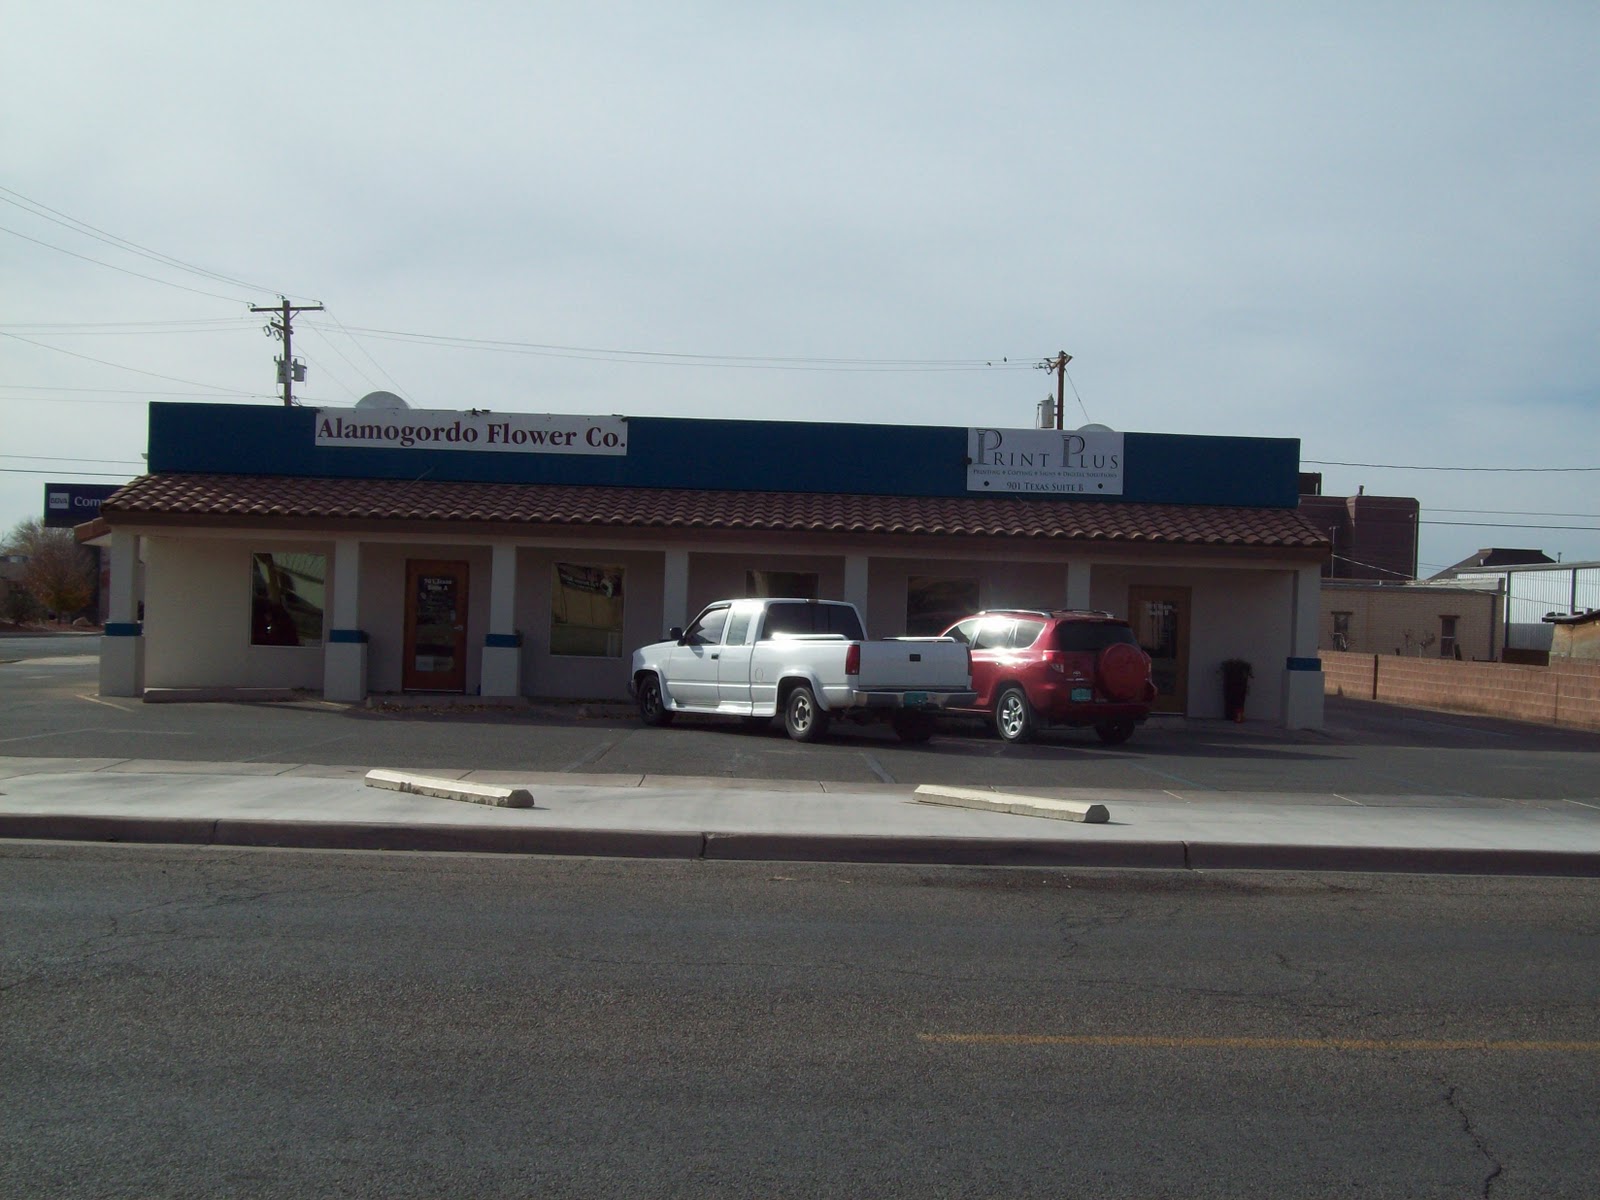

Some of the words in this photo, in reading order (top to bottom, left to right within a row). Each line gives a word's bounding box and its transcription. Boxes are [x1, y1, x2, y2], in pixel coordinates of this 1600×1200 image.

[317, 418, 479, 447] Alamogordo
[486, 423, 578, 446] Flower
[586, 426, 626, 448] Co.
[1006, 481, 1021, 490] 901
[1078, 483, 1084, 491] B
